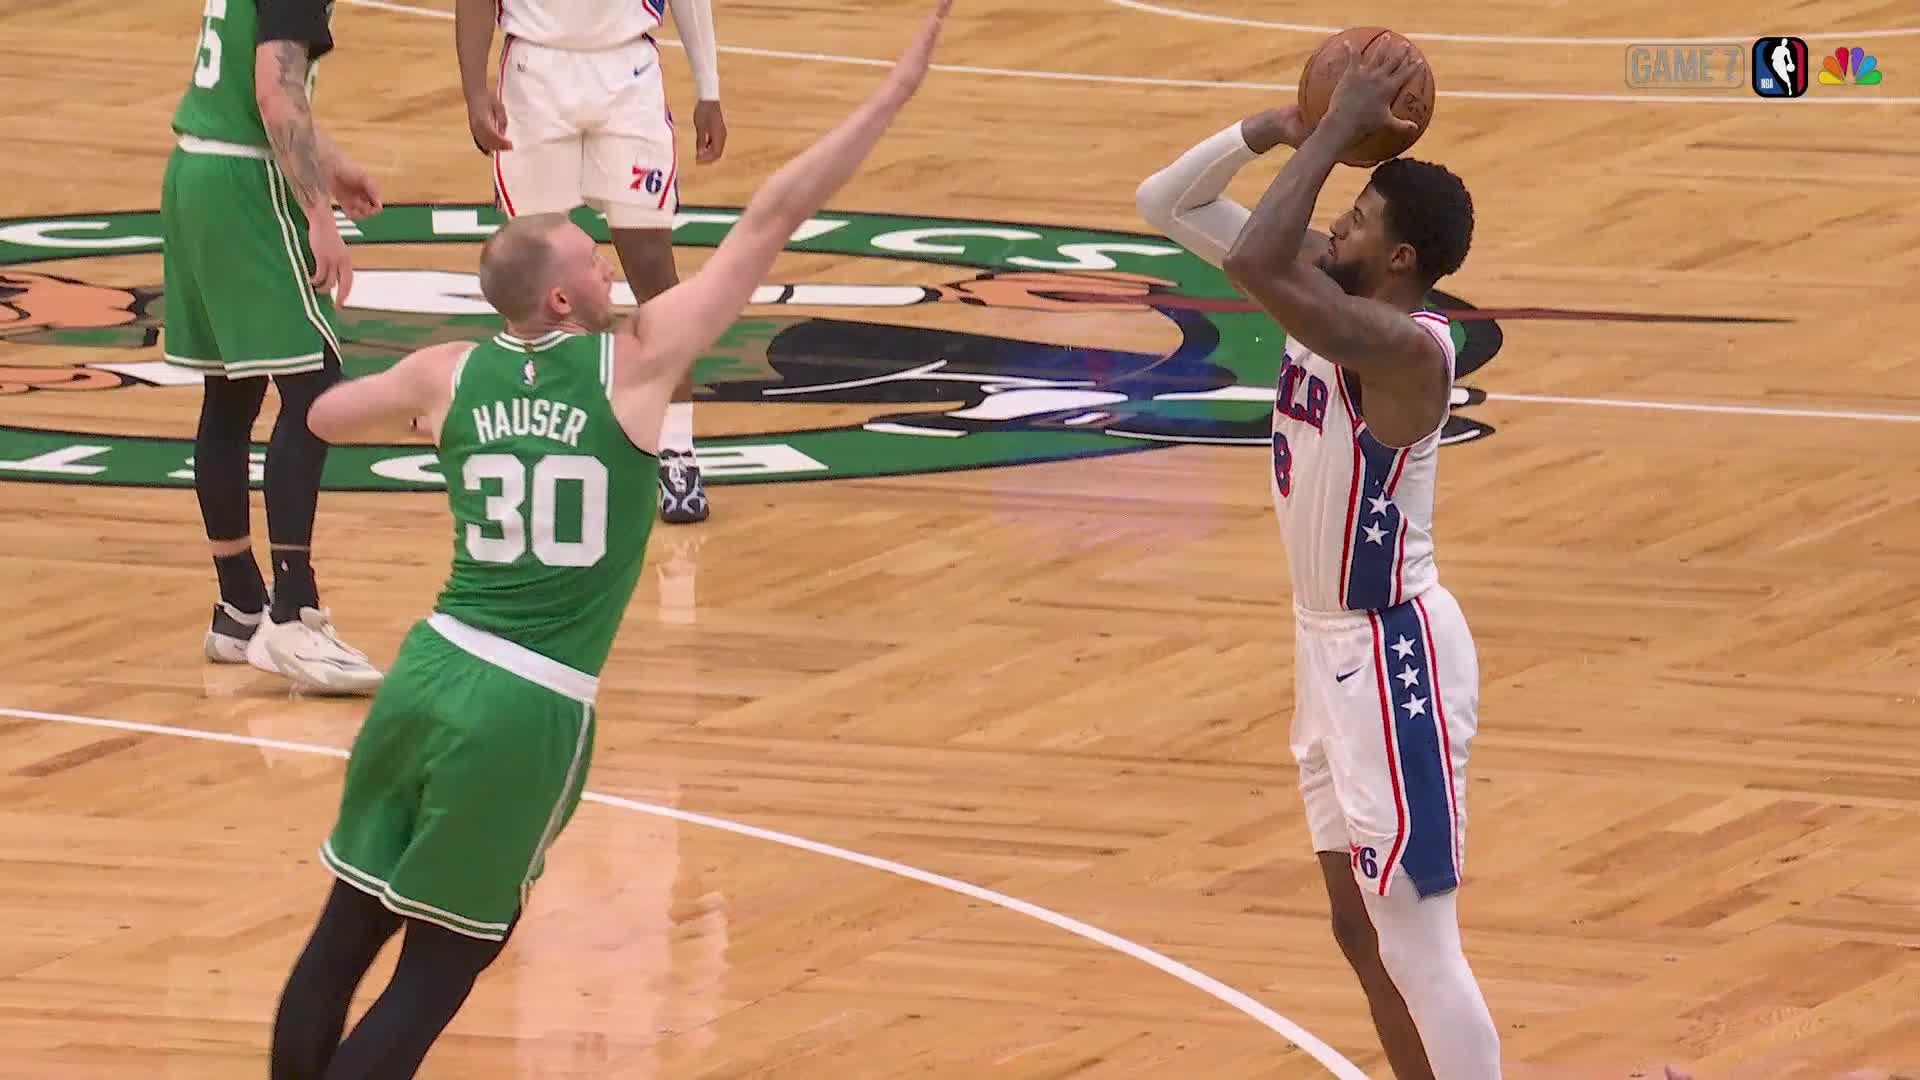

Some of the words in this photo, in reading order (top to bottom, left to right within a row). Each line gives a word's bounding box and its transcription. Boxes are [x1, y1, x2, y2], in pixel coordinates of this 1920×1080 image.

[630, 165, 662, 194] 76
[472, 398, 588, 447] HAUSER
[462, 453, 609, 567] 30
